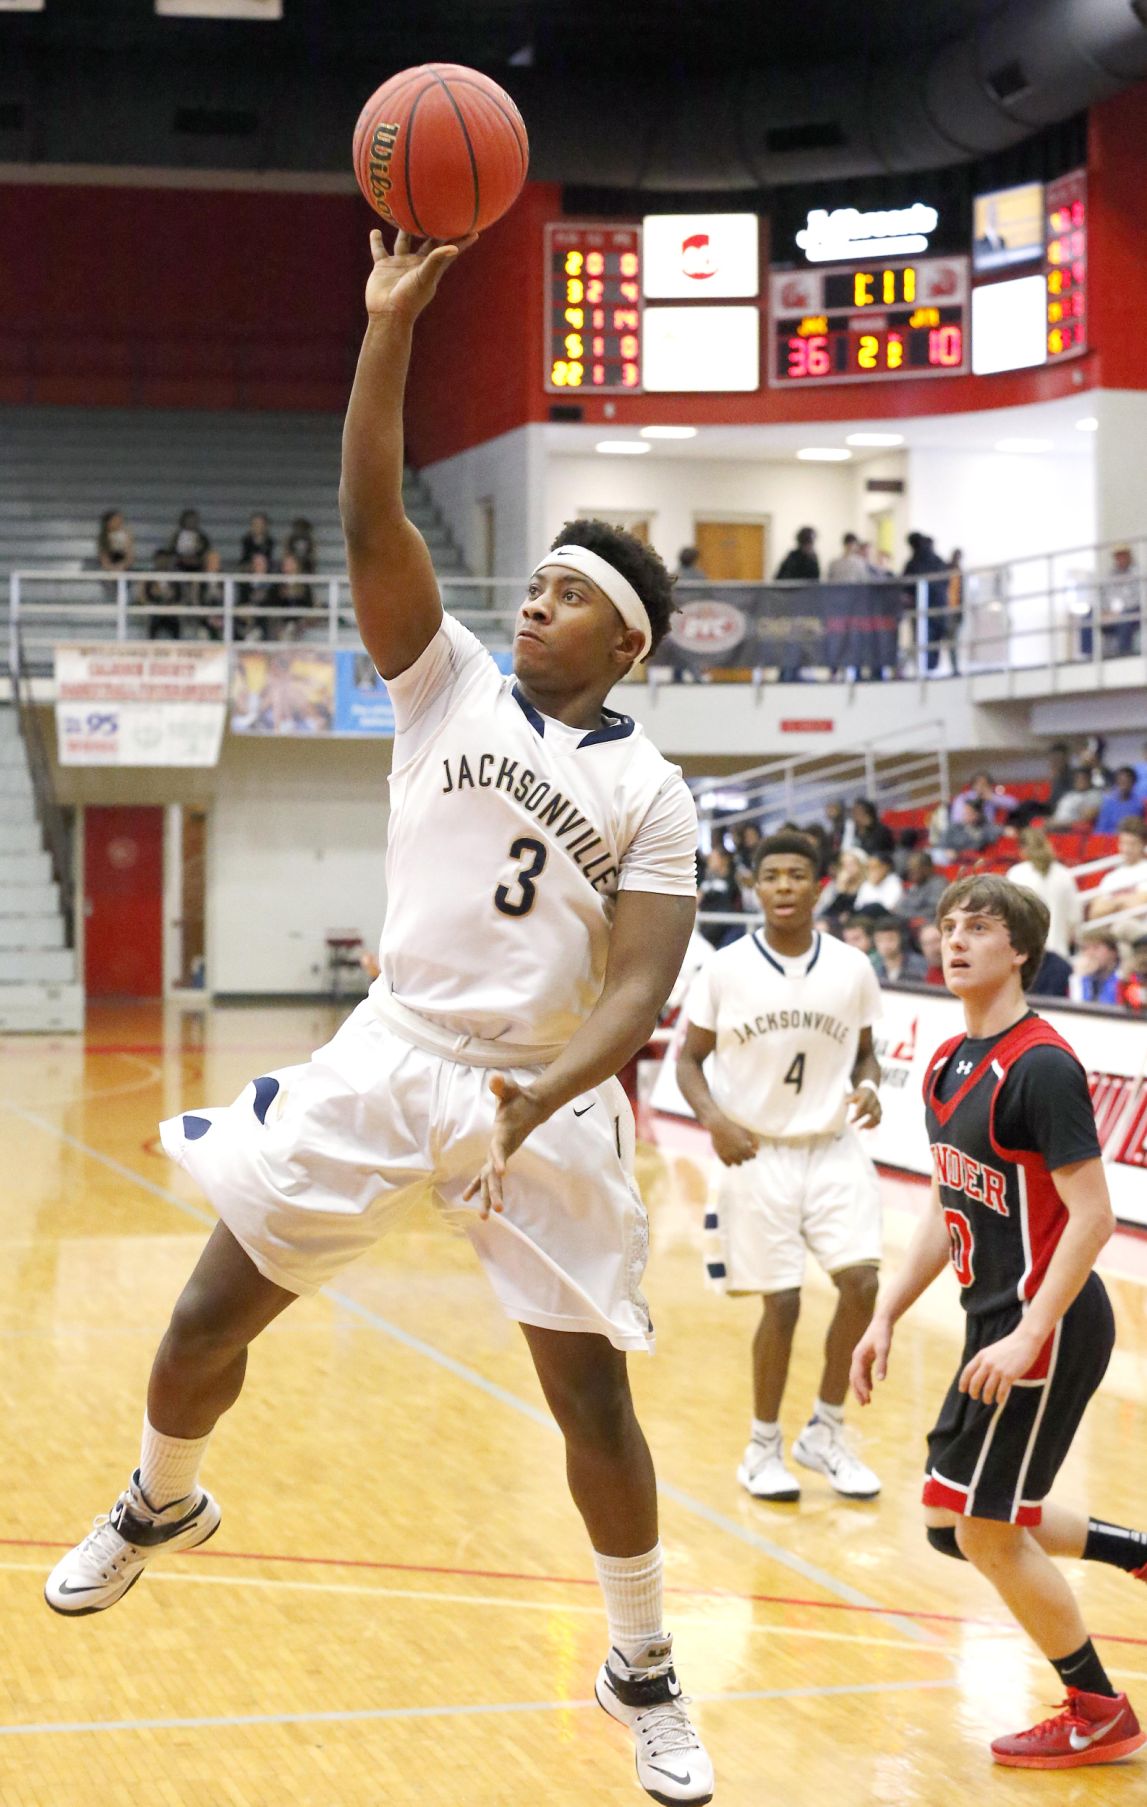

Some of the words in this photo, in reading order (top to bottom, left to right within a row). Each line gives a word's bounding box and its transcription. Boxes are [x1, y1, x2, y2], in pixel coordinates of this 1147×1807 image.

[369, 122, 400, 222] Wilso
[564, 251, 584, 276] 2
[564, 333, 584, 359] 5
[790, 337, 830, 377] 36
[928, 326, 961, 366] 10
[551, 361, 584, 386] 22
[443, 754, 617, 892] JACKSONVILLE
[494, 837, 547, 916] 3
[732, 1009, 849, 1045] JACKSONVILLE
[783, 1052, 806, 1095] 4
[930, 1142, 1010, 1218] NDER
